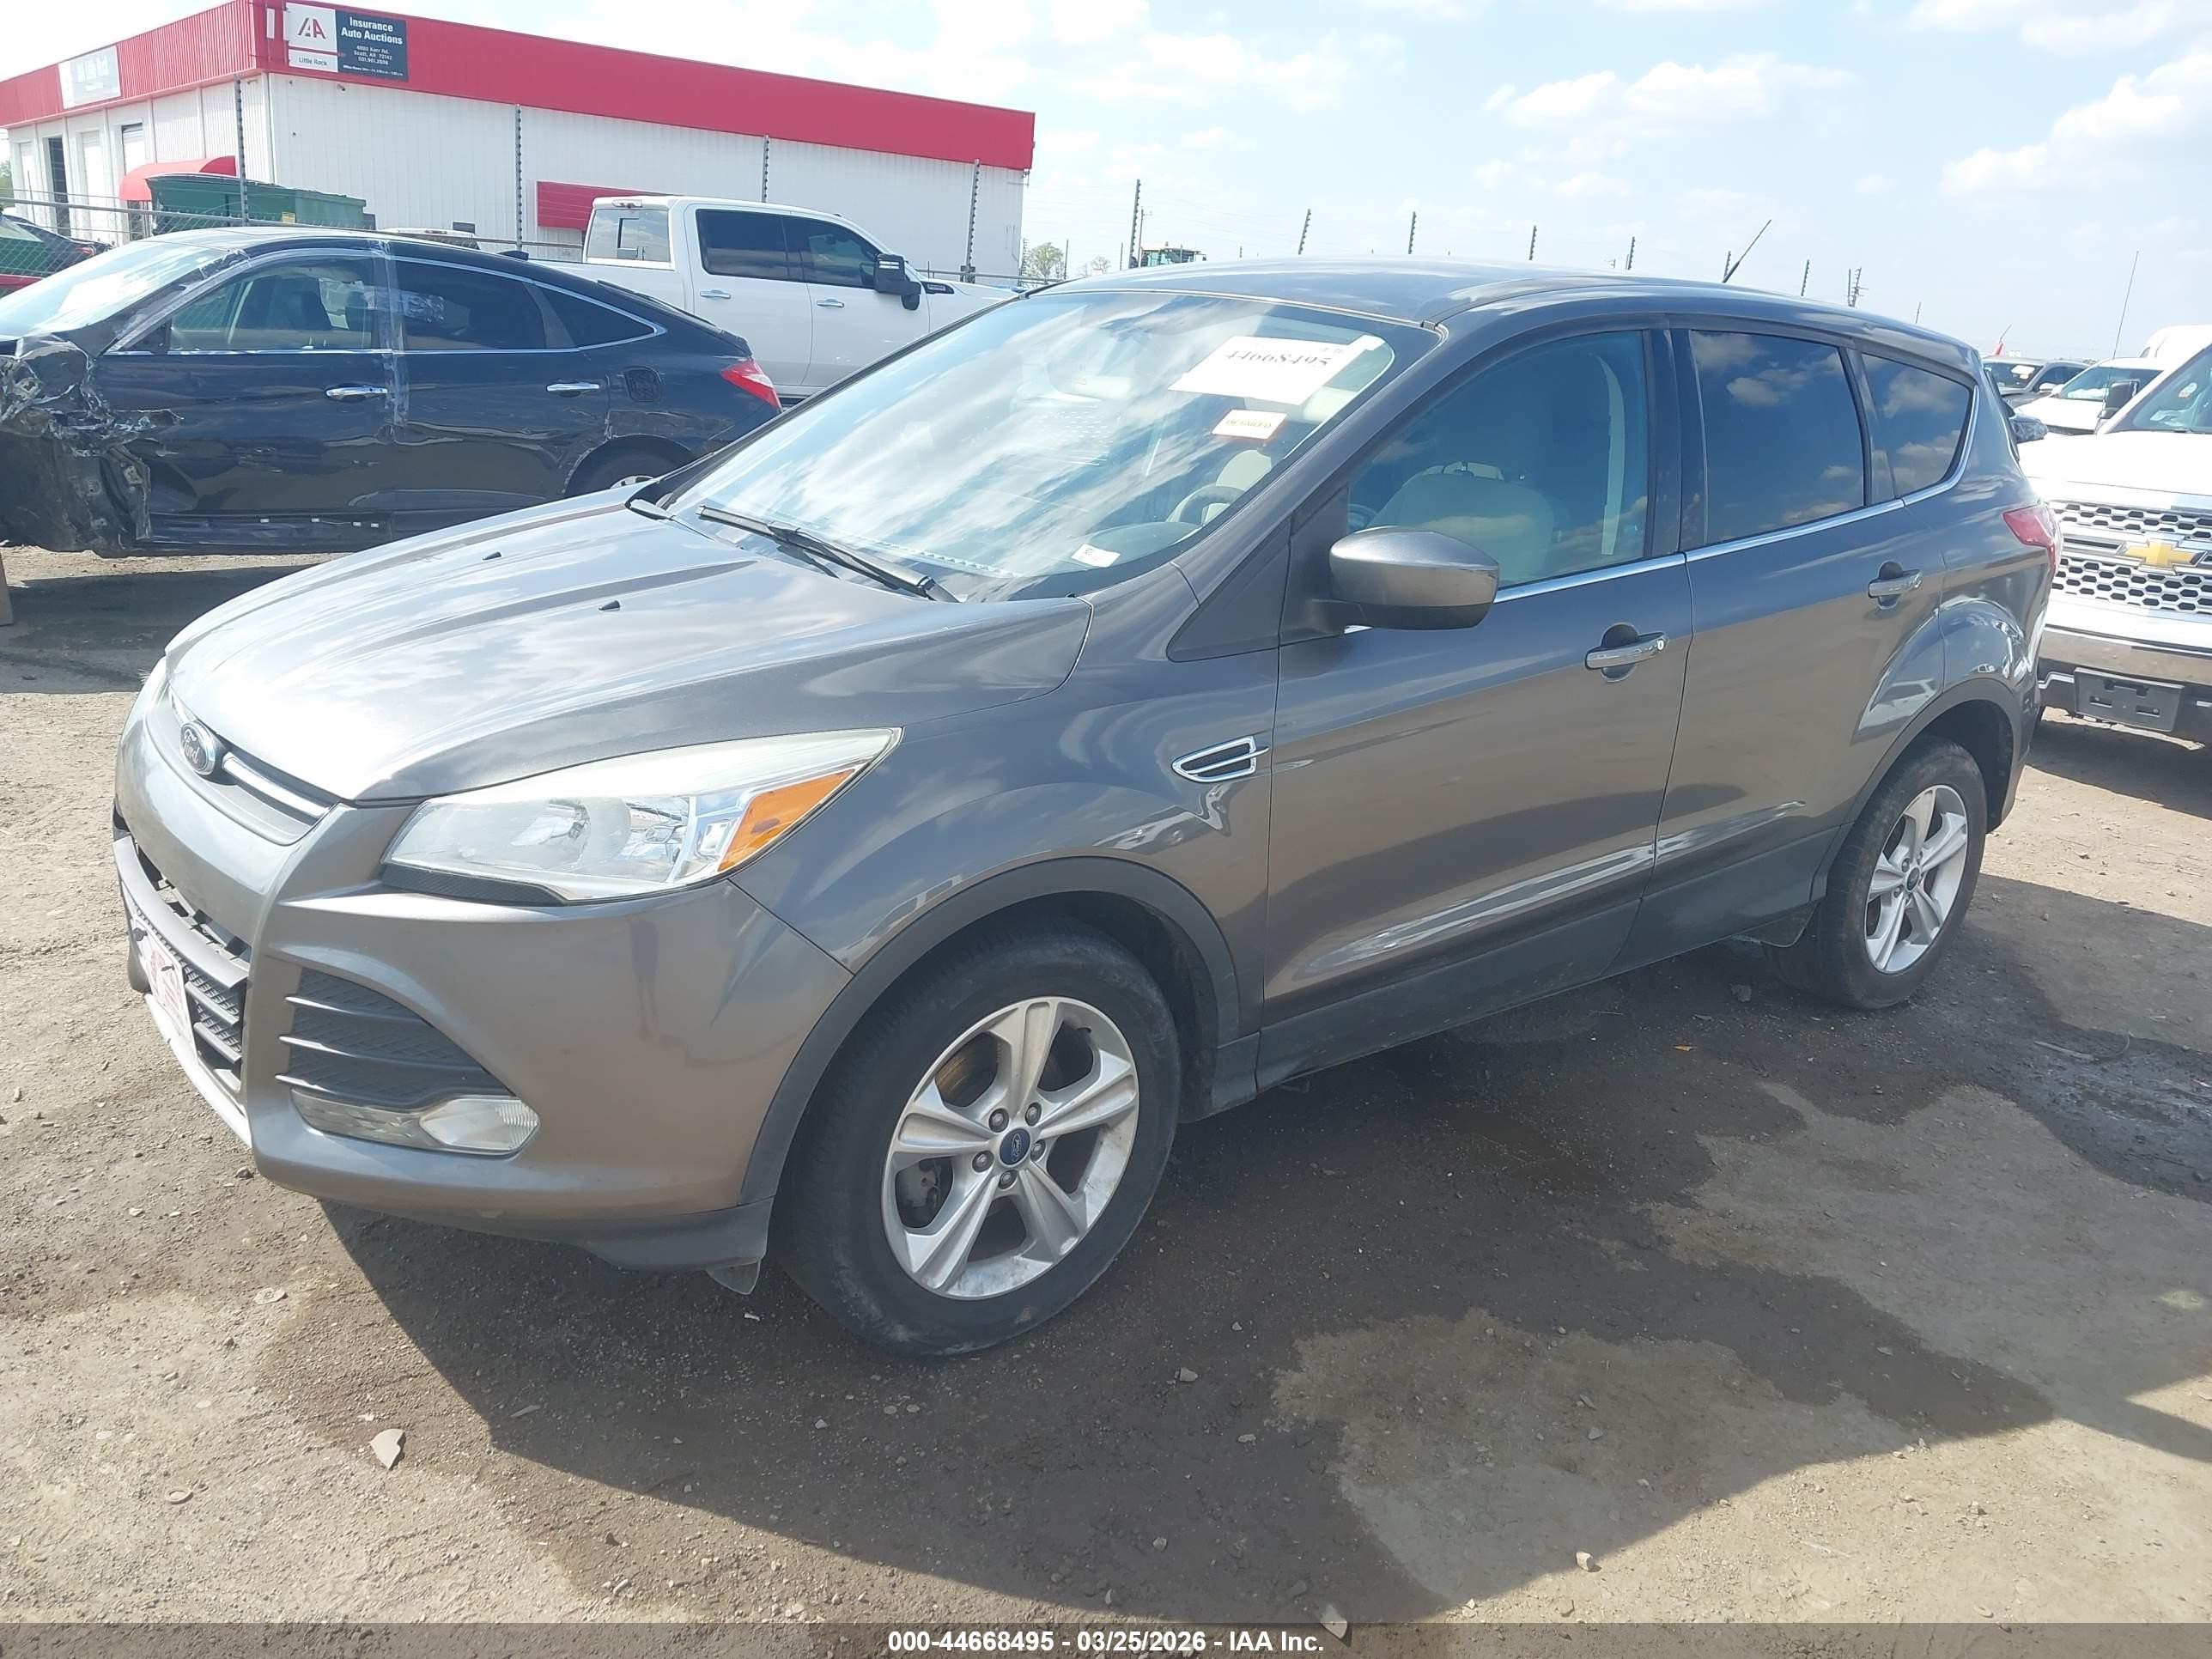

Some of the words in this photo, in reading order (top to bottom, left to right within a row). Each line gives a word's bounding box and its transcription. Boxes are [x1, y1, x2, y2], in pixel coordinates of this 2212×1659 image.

[349, 16, 393, 32] Insurance
[341, 27, 362, 39] Auto
[364, 30, 404, 45] Auctions
[183, 728, 201, 764] Ford
